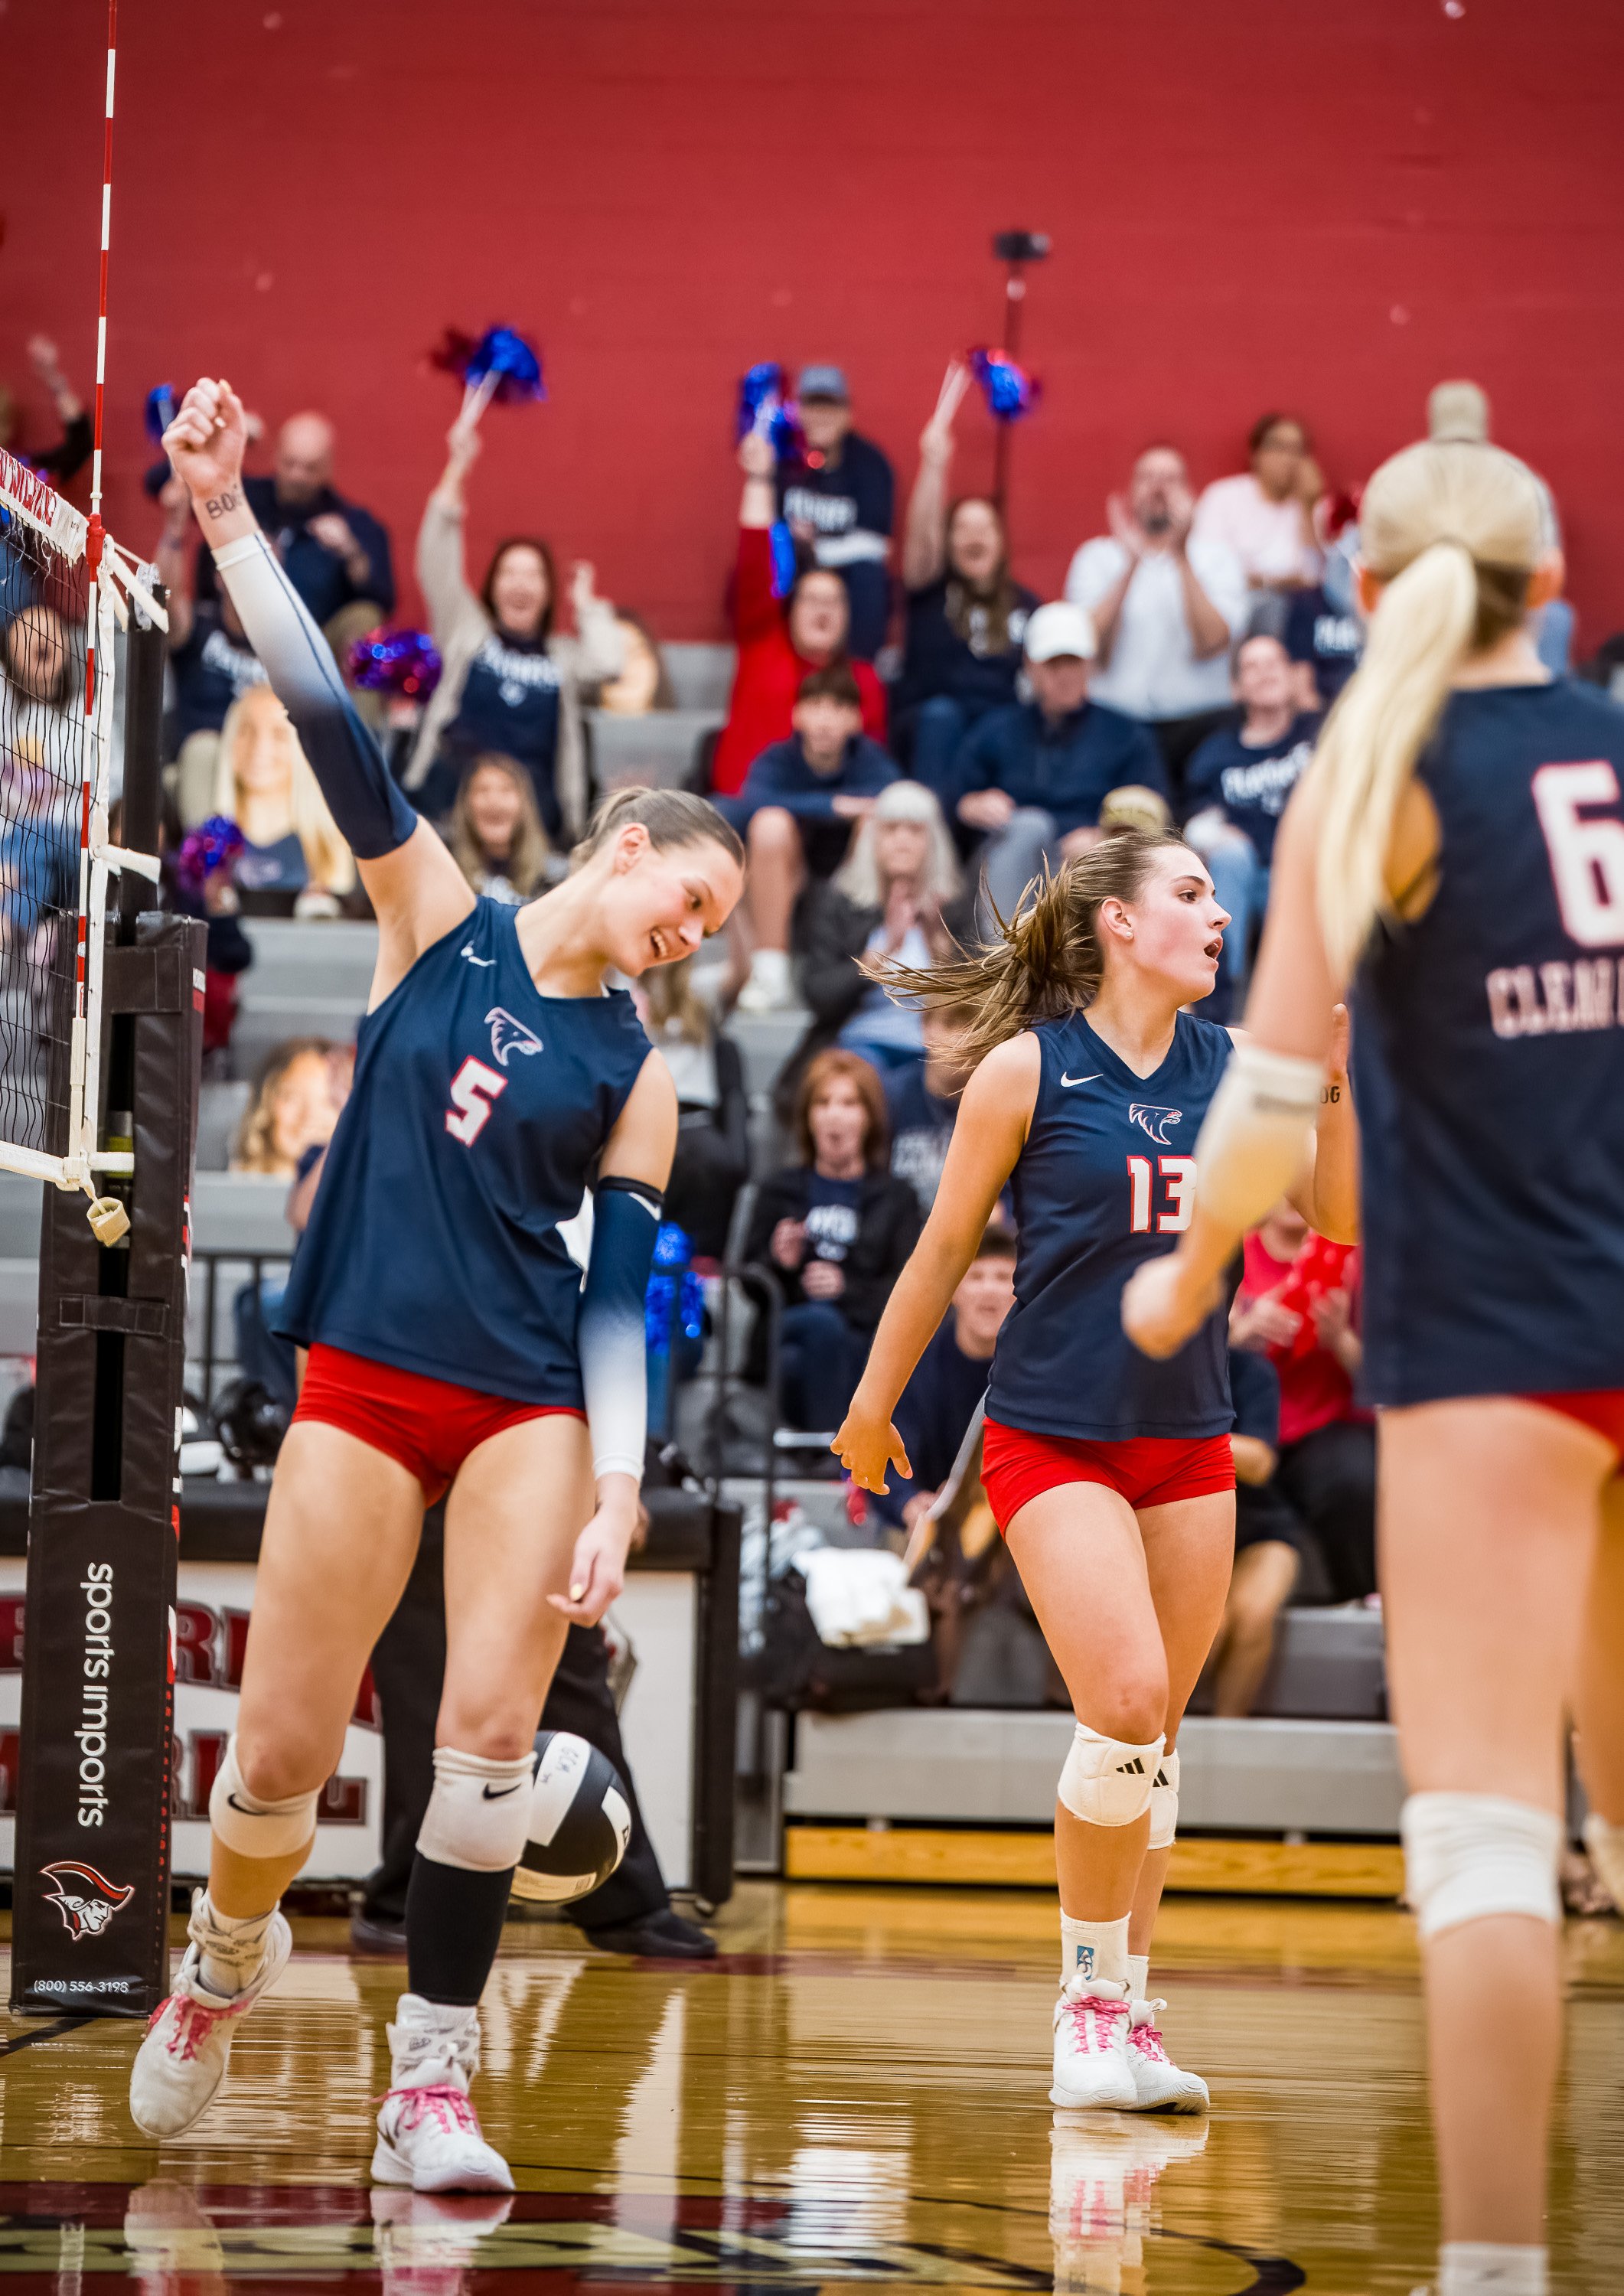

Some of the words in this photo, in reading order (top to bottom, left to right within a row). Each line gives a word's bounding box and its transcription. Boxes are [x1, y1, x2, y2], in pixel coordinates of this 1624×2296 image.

[1531, 759, 1624, 947] 6
[445, 1054, 508, 1148] 5
[1126, 1155, 1197, 1234] 13
[80, 1562, 115, 1678] sports
[74, 1685, 109, 1828] imports
[34, 1979, 67, 1993] (800)
[69, 1981, 129, 1994] 556-3198
